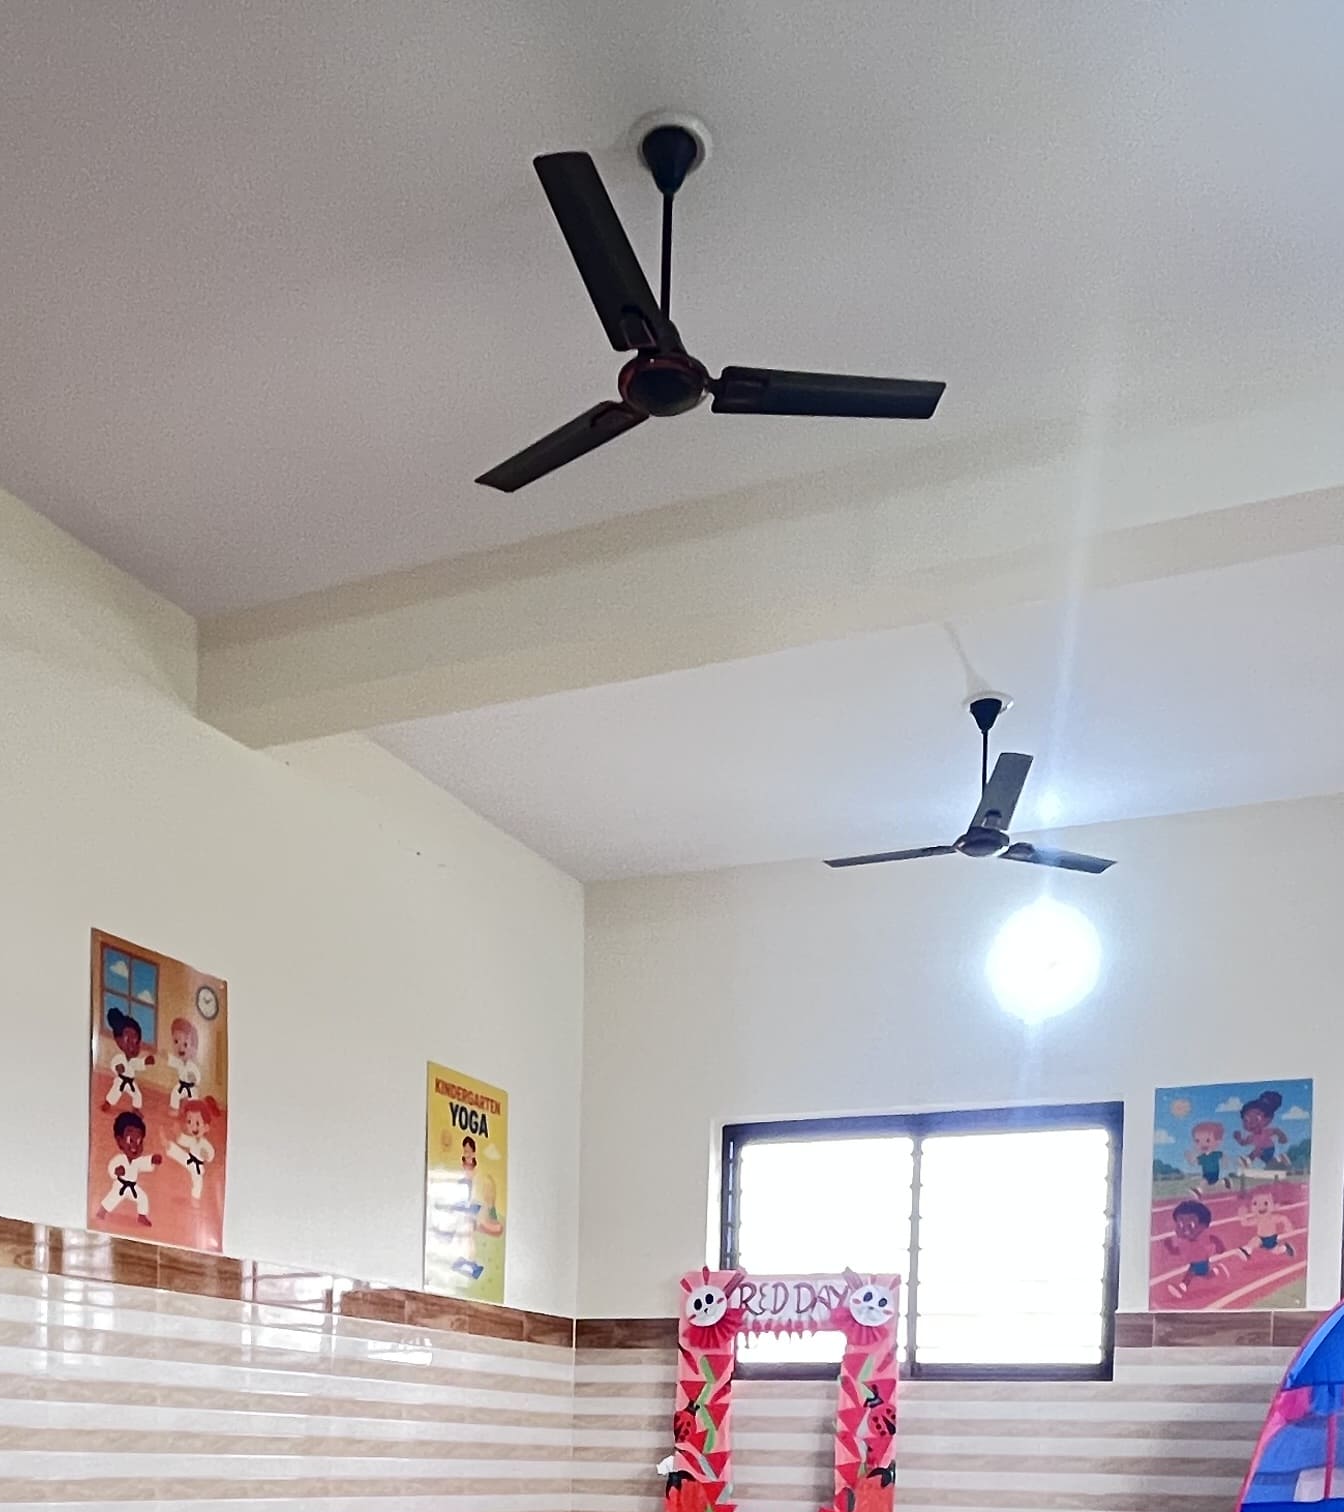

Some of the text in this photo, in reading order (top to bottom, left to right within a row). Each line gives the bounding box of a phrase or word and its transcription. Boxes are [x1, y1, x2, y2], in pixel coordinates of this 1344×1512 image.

[435, 1078, 501, 1115] KINDERGARTEN
[449, 1102, 489, 1138] YOGA
[739, 1282, 849, 1315] RED DAY
